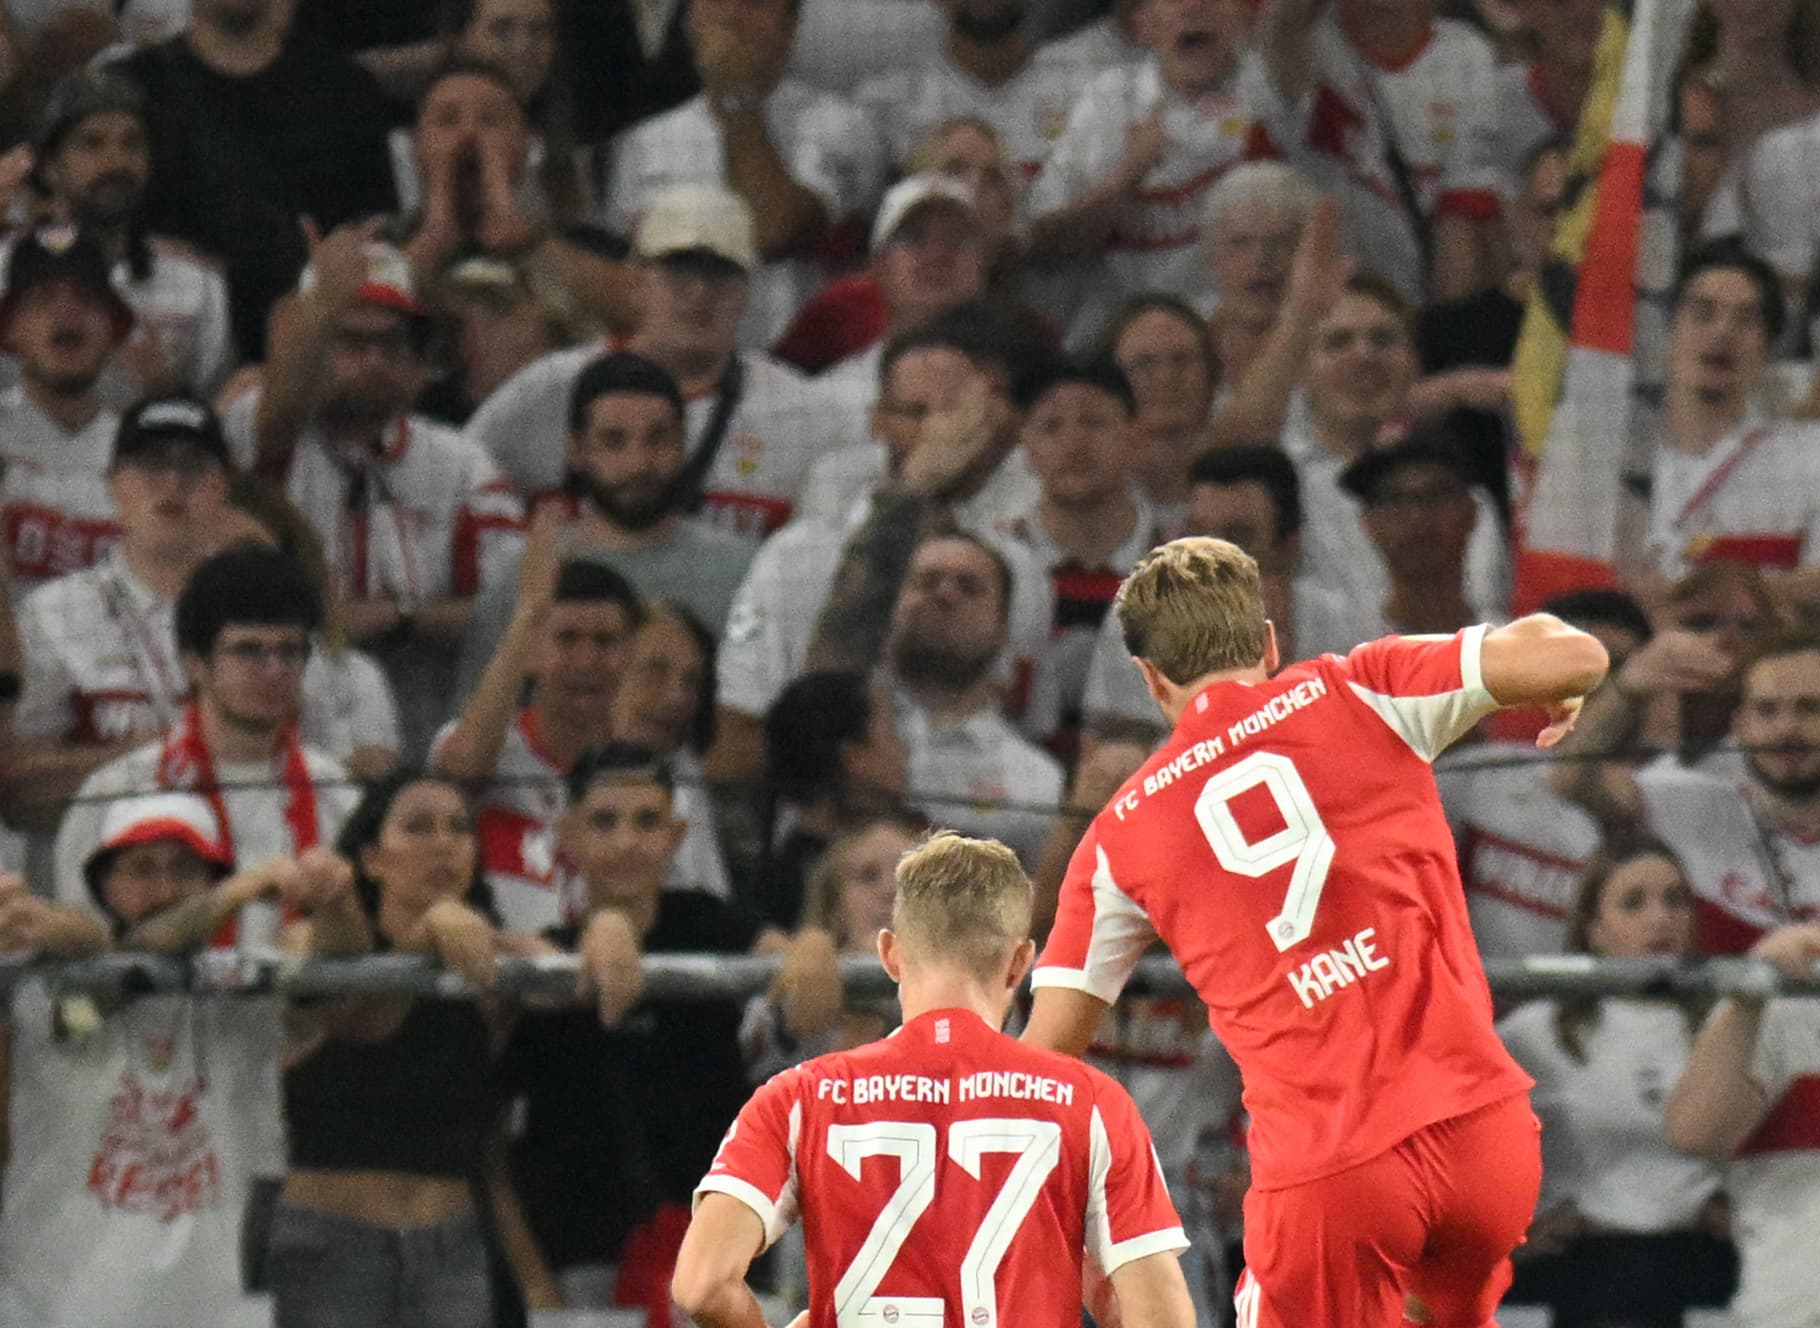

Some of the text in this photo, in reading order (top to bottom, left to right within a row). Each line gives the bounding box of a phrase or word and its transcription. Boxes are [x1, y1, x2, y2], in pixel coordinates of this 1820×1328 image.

[1113, 790, 1139, 821] FC
[1143, 736, 1225, 797] BAYERN
[1194, 752, 1336, 952] 9
[1287, 928, 1389, 1009] KANE
[818, 1078, 848, 1104] FC
[853, 1074, 950, 1105] BAYERN
